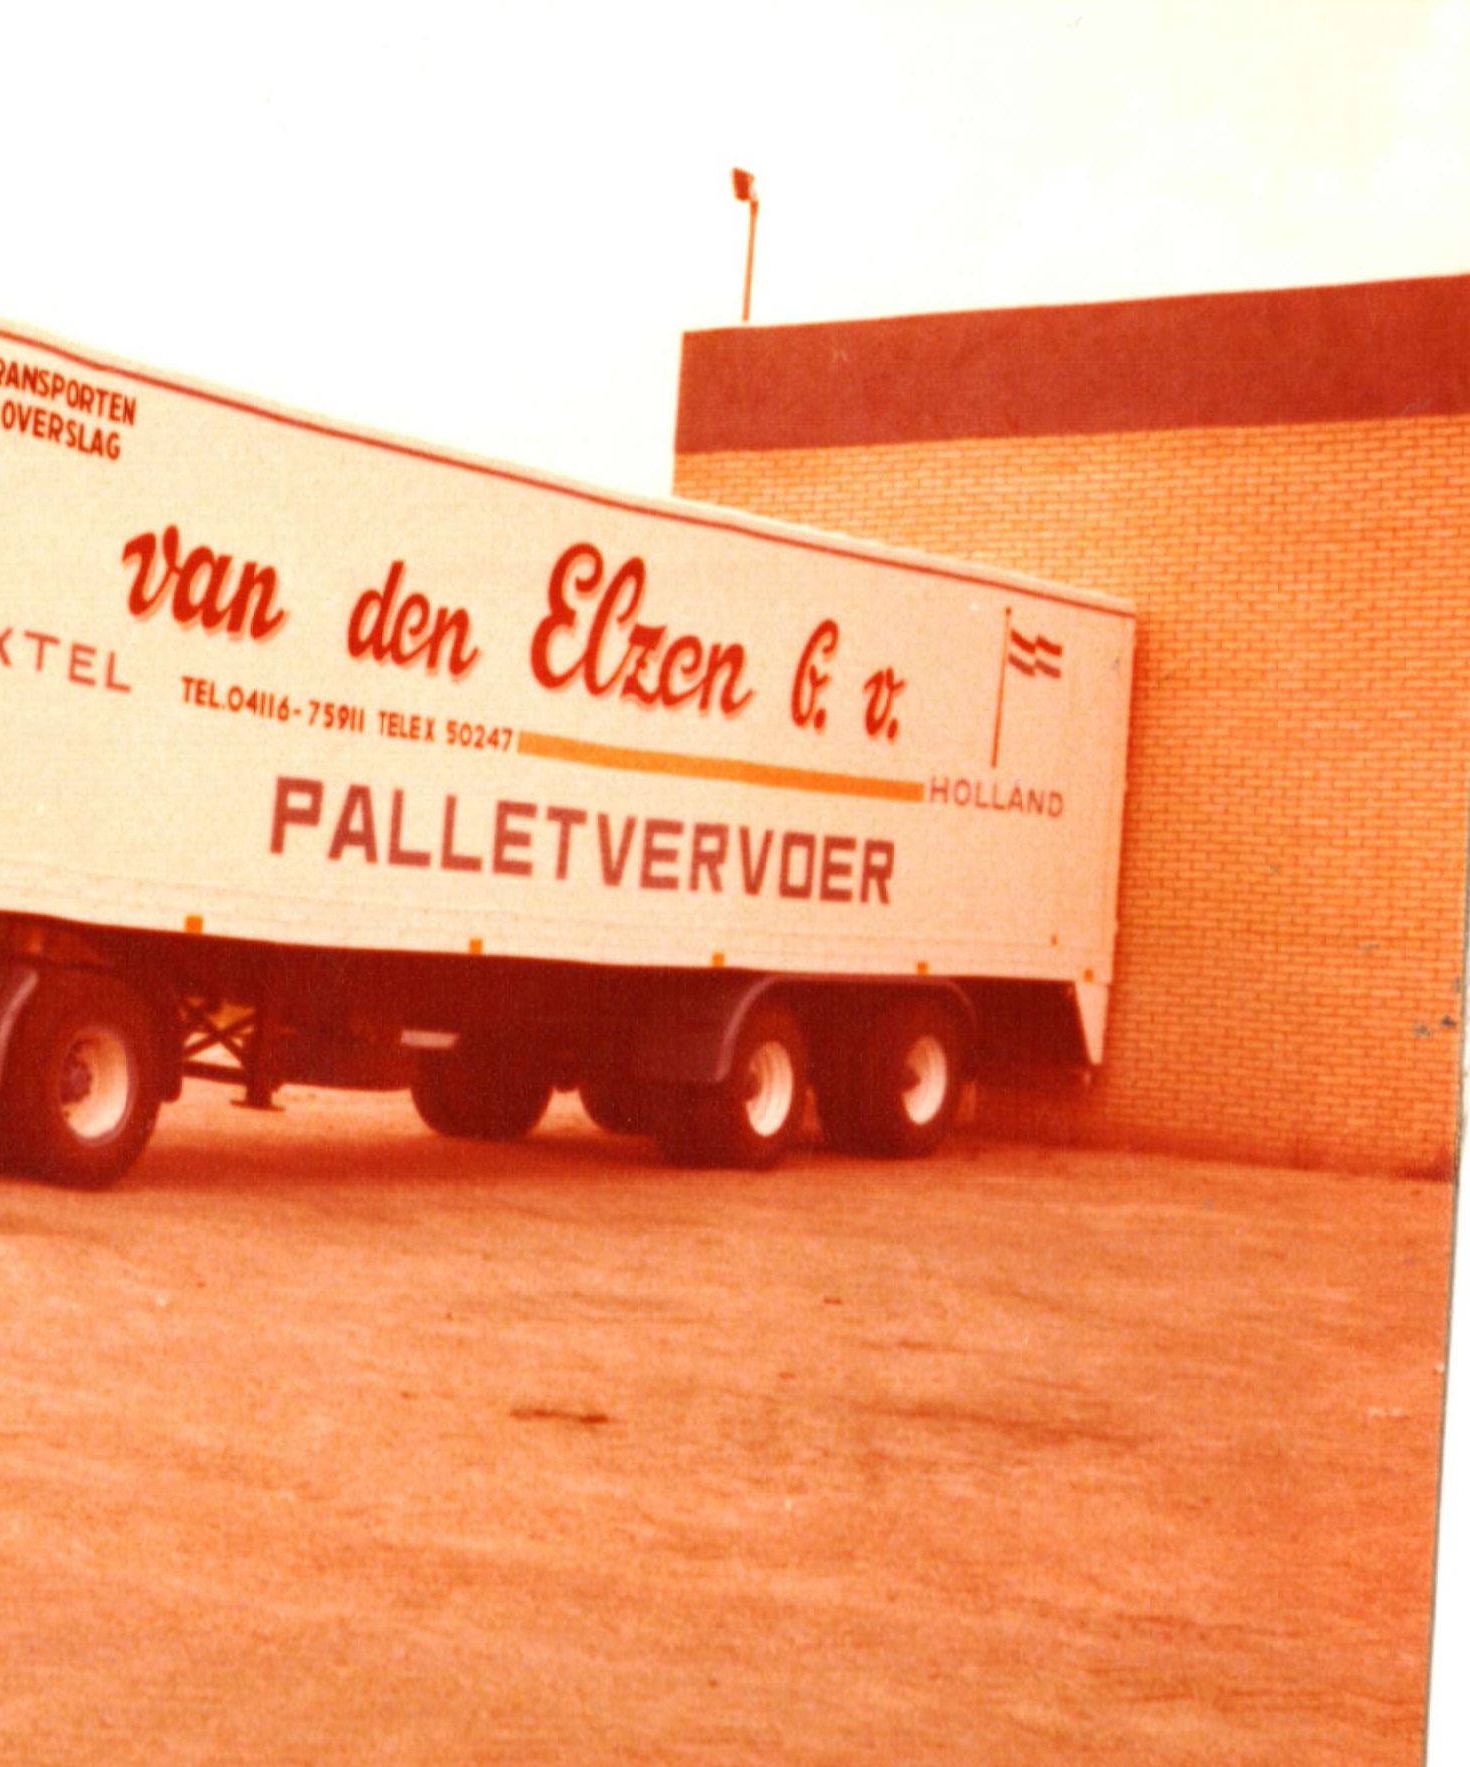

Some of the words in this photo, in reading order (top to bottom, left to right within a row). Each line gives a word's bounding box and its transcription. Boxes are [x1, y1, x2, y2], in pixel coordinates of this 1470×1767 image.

[1, 399, 122, 461] OVERSLAG
[122, 524, 287, 645] van
[347, 560, 482, 680] den
[530, 542, 754, 716] Elzen
[379, 710, 436, 742] TELEX
[446, 719, 513, 752] 50247
[929, 775, 1065, 819] HOLLAND
[269, 775, 896, 905] PALLETVERVOER
